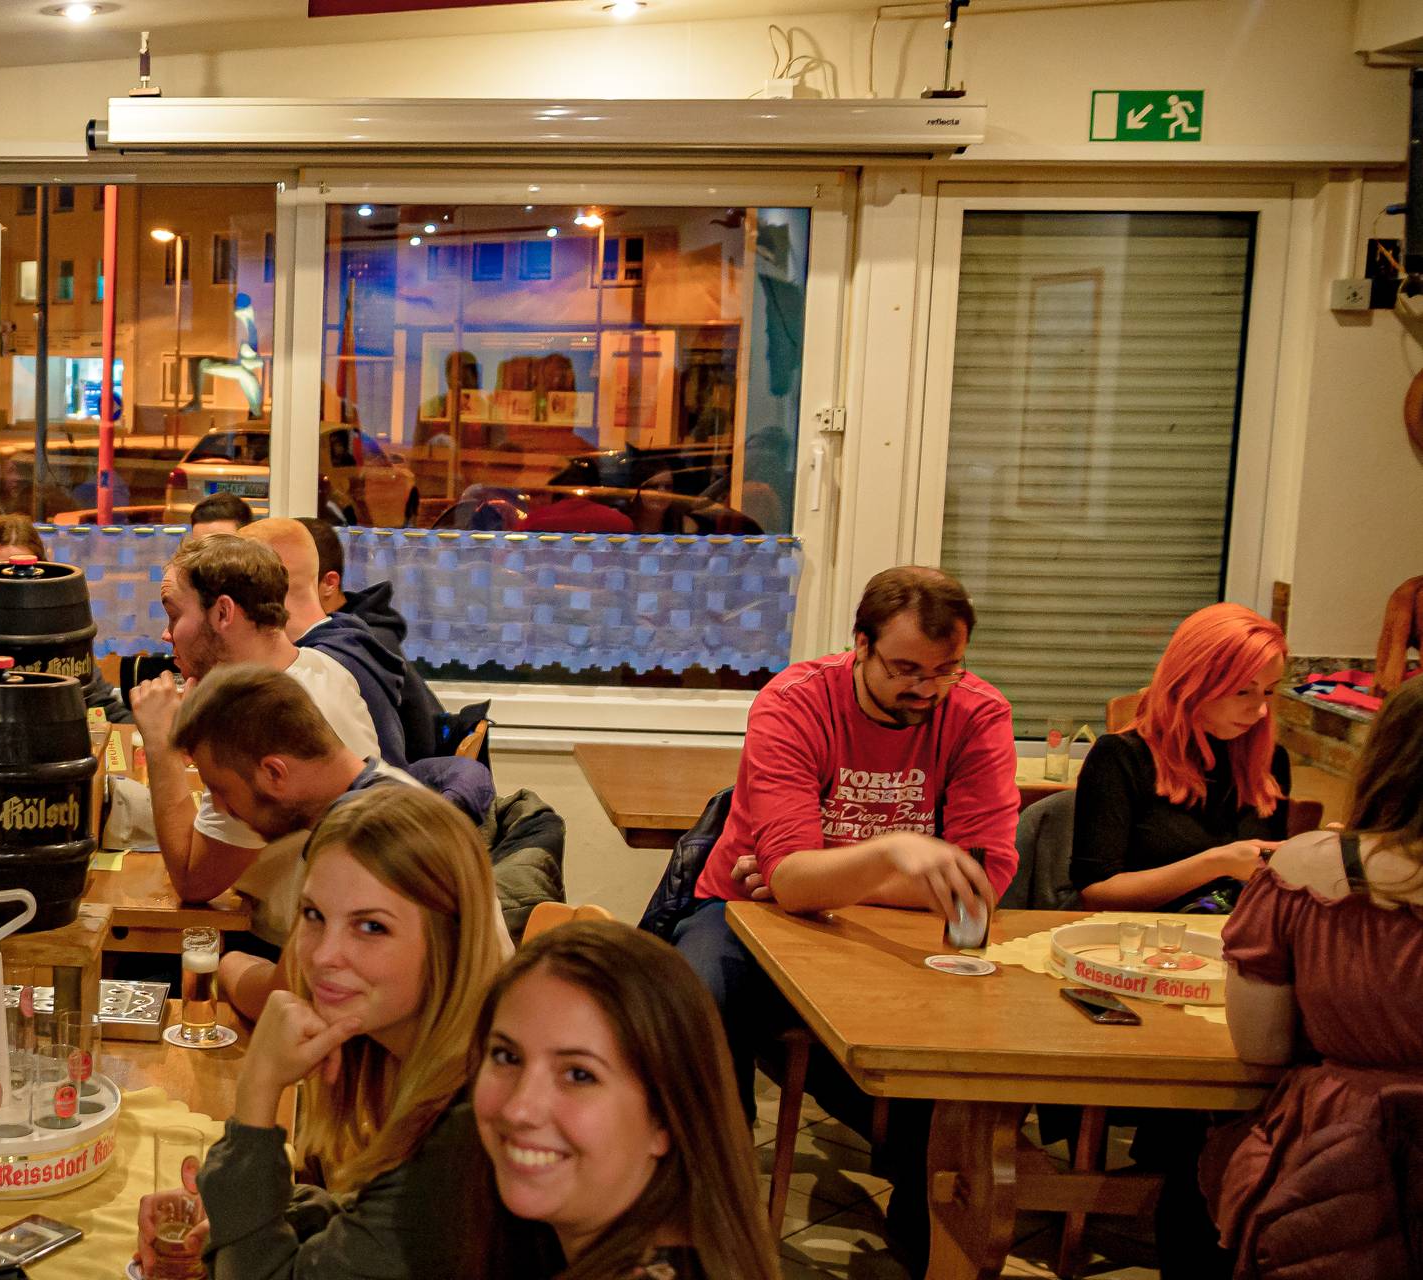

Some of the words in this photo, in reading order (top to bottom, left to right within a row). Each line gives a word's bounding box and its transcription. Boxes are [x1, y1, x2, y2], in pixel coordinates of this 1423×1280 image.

[840, 803, 888, 826] Diego
[892, 802, 935, 822] Bowl
[1075, 960, 1148, 993] Reissdorf
[1153, 977, 1211, 1001] Kölsch
